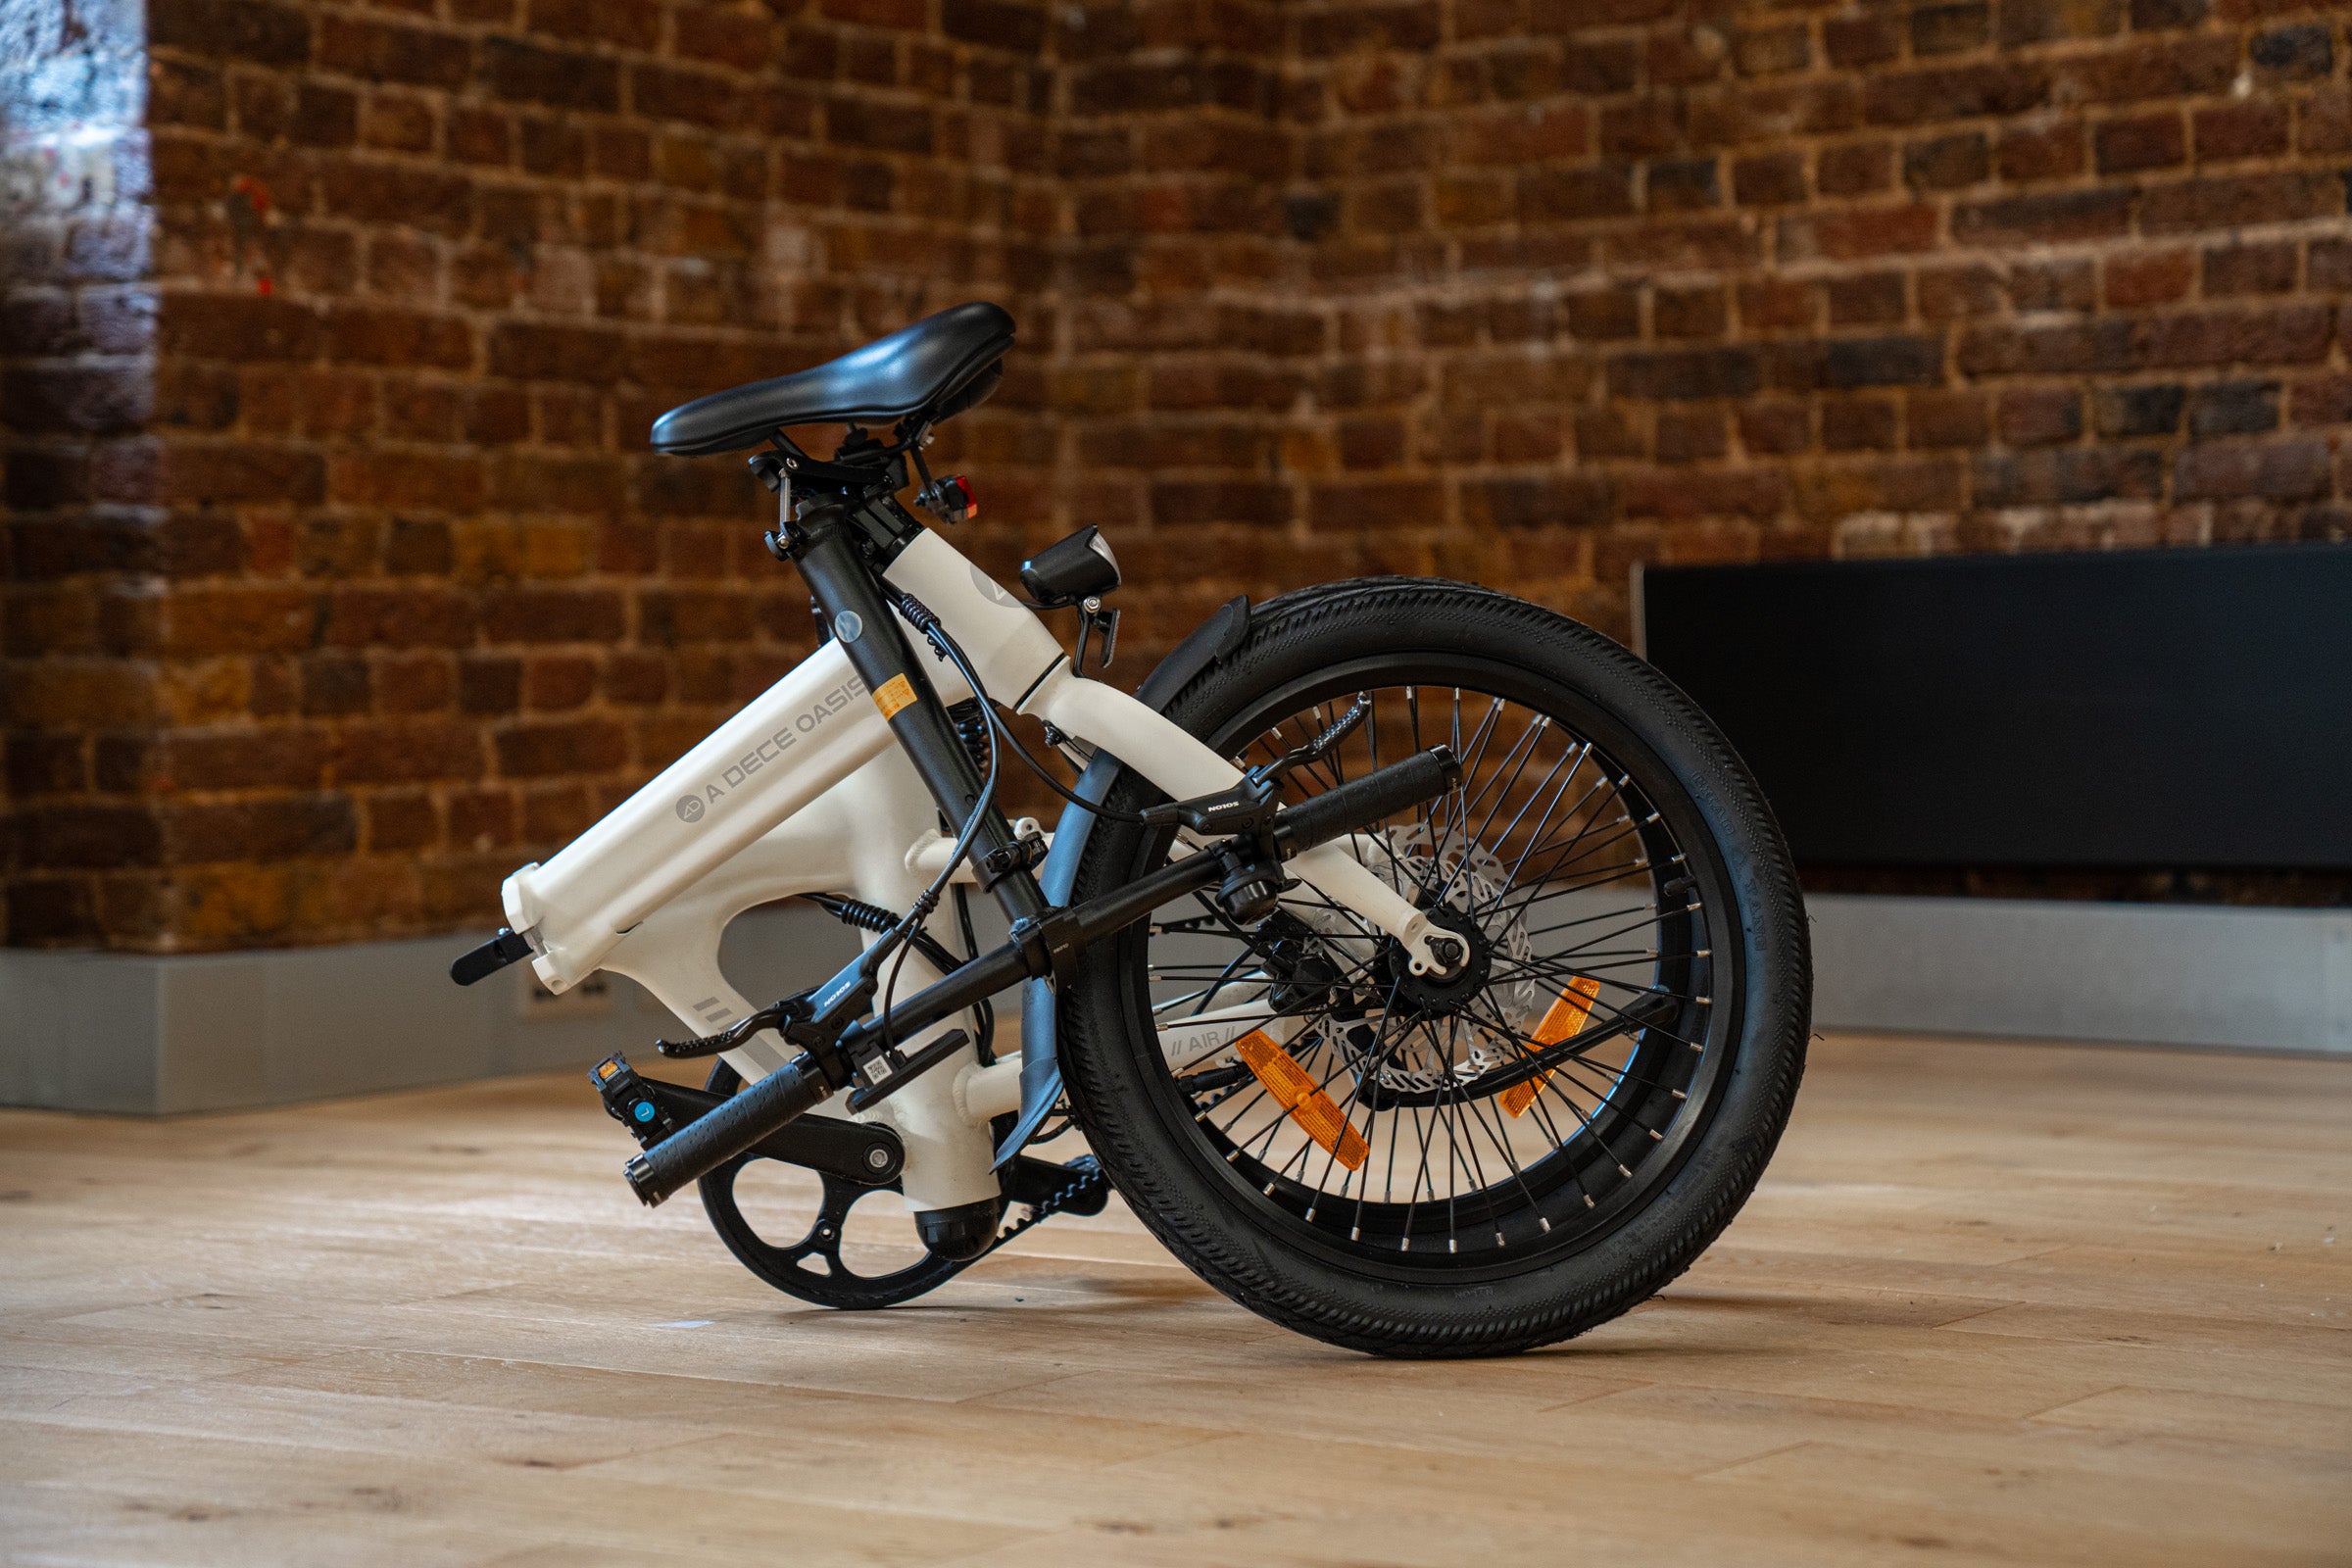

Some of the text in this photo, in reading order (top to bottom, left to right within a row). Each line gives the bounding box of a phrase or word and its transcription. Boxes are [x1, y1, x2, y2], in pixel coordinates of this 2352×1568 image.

[705, 783, 725, 805] A
[721, 727, 797, 788] DECE
[796, 675, 866, 733] OASIS
[1207, 801, 1240, 812] SOLON
[824, 981, 851, 1006] SOLON
[1189, 1031, 1221, 1053] AIR
